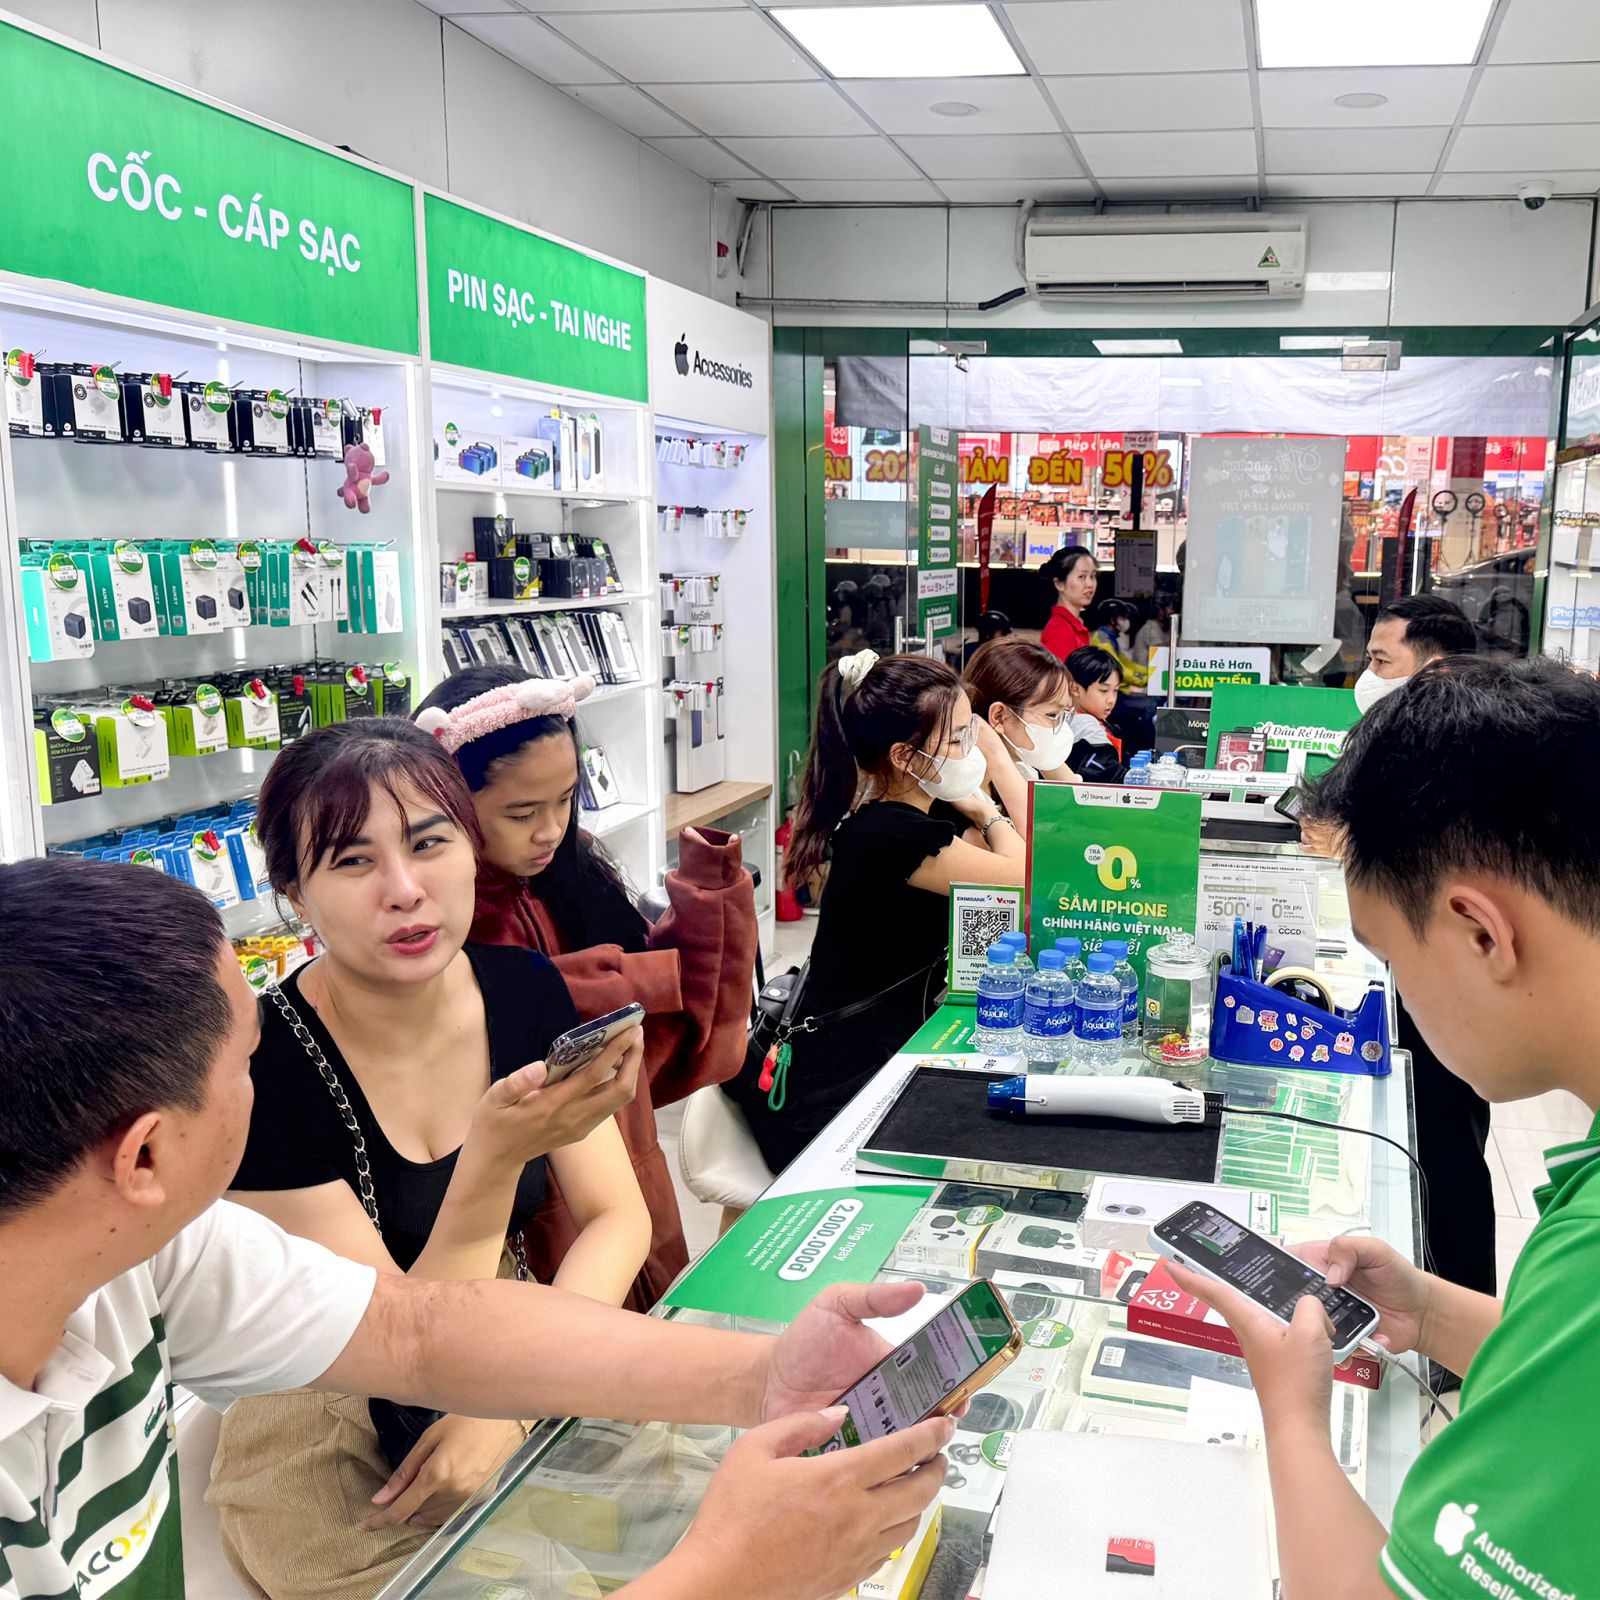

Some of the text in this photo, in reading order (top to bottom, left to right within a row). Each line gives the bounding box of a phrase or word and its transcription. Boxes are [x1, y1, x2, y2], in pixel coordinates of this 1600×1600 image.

[87, 150, 362, 277] CỐC - CÁP SẠC
[448, 269, 487, 312] PIN
[493, 282, 535, 329] SẠC
[550, 300, 580, 338] TAI
[583, 310, 633, 352] NGHE
[693, 350, 753, 390] Accessories
[1063, 433, 1090, 453] Bếp
[1029, 449, 1083, 485] ĐẾN
[1029, 544, 1054, 555] intel
[102, 587, 110, 609] AUKEY
[1183, 659, 1207, 669] Đâu
[1210, 657, 1225, 669] Rẻ
[1228, 659, 1253, 670] Hơn
[1175, 674, 1214, 688] HOÀN
[1273, 726, 1295, 737] Đâu
[1314, 729, 1336, 740] Hơn
[1058, 892, 1168, 918] SẮM IPHONE
[1213, 900, 1245, 917] 500
[1271, 903, 1283, 919] 0
[1042, 915, 1183, 937] CHÍNH HÃNG VIỆT NAM
[1204, 923, 1218, 931] 10%
[1278, 928, 1302, 936] CCCD
[1081, 937, 1141, 956] siê ễ!
[978, 1007, 1009, 1018] AquaLife
[1082, 1020, 1115, 1030] AquaLife
[787, 1204, 855, 1274] 2.000.000đ
[833, 1223, 874, 1263] Tặng ngay
